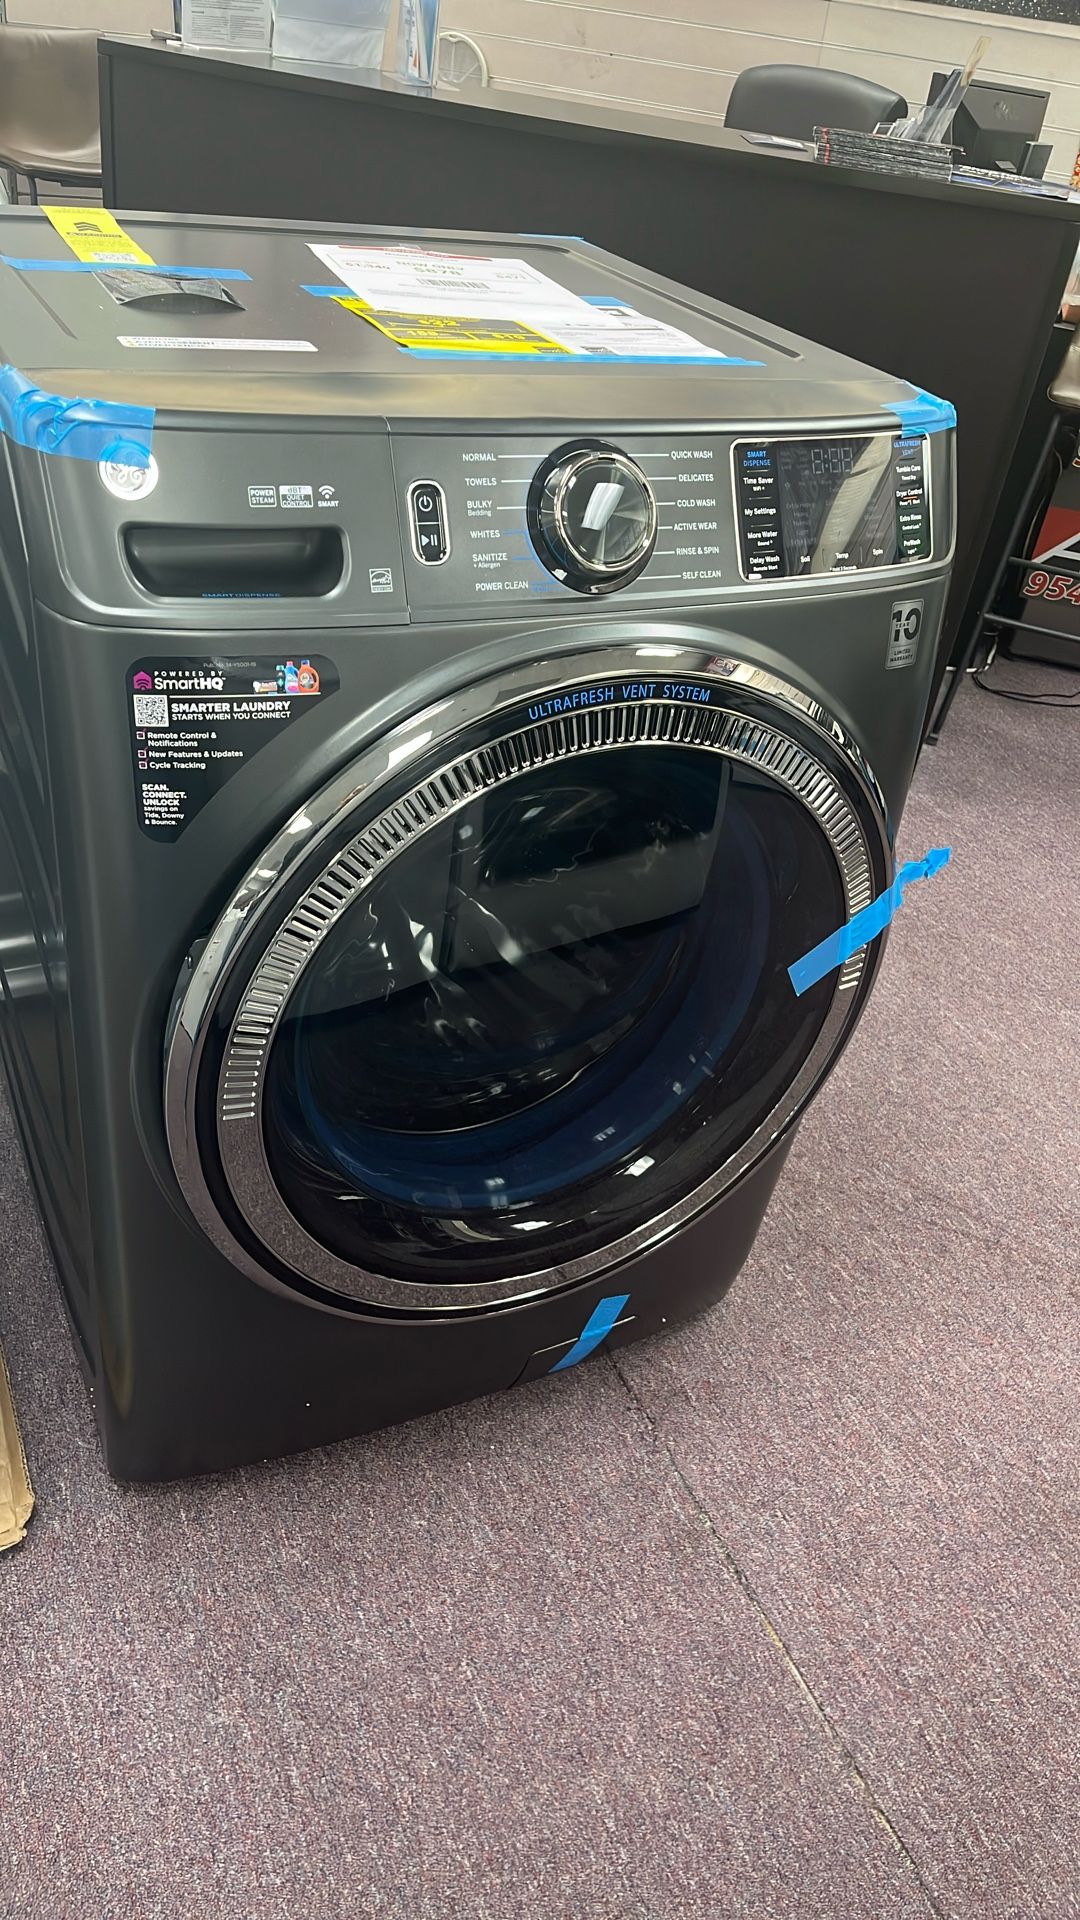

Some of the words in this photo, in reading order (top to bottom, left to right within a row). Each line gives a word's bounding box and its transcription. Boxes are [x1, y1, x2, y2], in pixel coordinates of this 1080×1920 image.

[462, 453, 496, 462] NORMAL
[670, 450, 690, 459] QUICK
[691, 450, 713, 459] WASH
[743, 459, 771, 467] DISPENSE
[910, 464, 921, 472] Care
[465, 477, 497, 486] TOWELS
[678, 474, 714, 482] DELICATES
[743, 477, 757, 485] Time
[757, 476, 774, 484] Saver
[250, 489, 274, 497] POWER
[896, 490, 908, 498] Dryer
[907, 488, 923, 496] Control
[251, 496, 274, 504] STEAM
[287, 494, 304, 502] QUIET
[317, 500, 339, 508] SMART
[466, 500, 492, 509] BULKY
[676, 499, 695, 508] COLD
[696, 499, 716, 507] WASH
[468, 508, 492, 518] Bedding
[744, 508, 753, 516] My
[754, 507, 776, 516] Settings
[673, 522, 695, 531] ACTIVE
[696, 522, 717, 530] WEAR
[470, 530, 500, 538] WHITES
[762, 530, 778, 538] Water
[676, 547, 696, 556] RINSE
[697, 547, 703, 555] &
[704, 546, 719, 554] SPIN
[872, 548, 883, 556] Spin
[472, 553, 508, 562] SANITIZE
[749, 556, 765, 564] Delay
[835, 552, 849, 560] Temp
[682, 571, 698, 579] SELF
[698, 570, 721, 578] CLEAN
[475, 582, 500, 592] POWER
[502, 580, 528, 590] CLEAN
[892, 608, 922, 642] 10
[171, 702, 230, 712] SMARTER
[233, 701, 290, 712] LAUNDRY
[528, 686, 614, 721] ULTRAFRESH
[622, 684, 657, 699] VENT
[662, 684, 711, 703] SYSTEM
[171, 713, 203, 721] STARTS
[232, 712, 250, 720] YOU
[252, 711, 291, 719] CONNECT
[179, 731, 210, 739] Control
[148, 750, 166, 758] New
[168, 750, 202, 758] Features
[211, 749, 244, 758] Updates
[149, 762, 171, 770] Cycle
[173, 761, 206, 770] Tracking
[142, 791, 187, 799] CONNECT.
[162, 812, 184, 820] Downy
